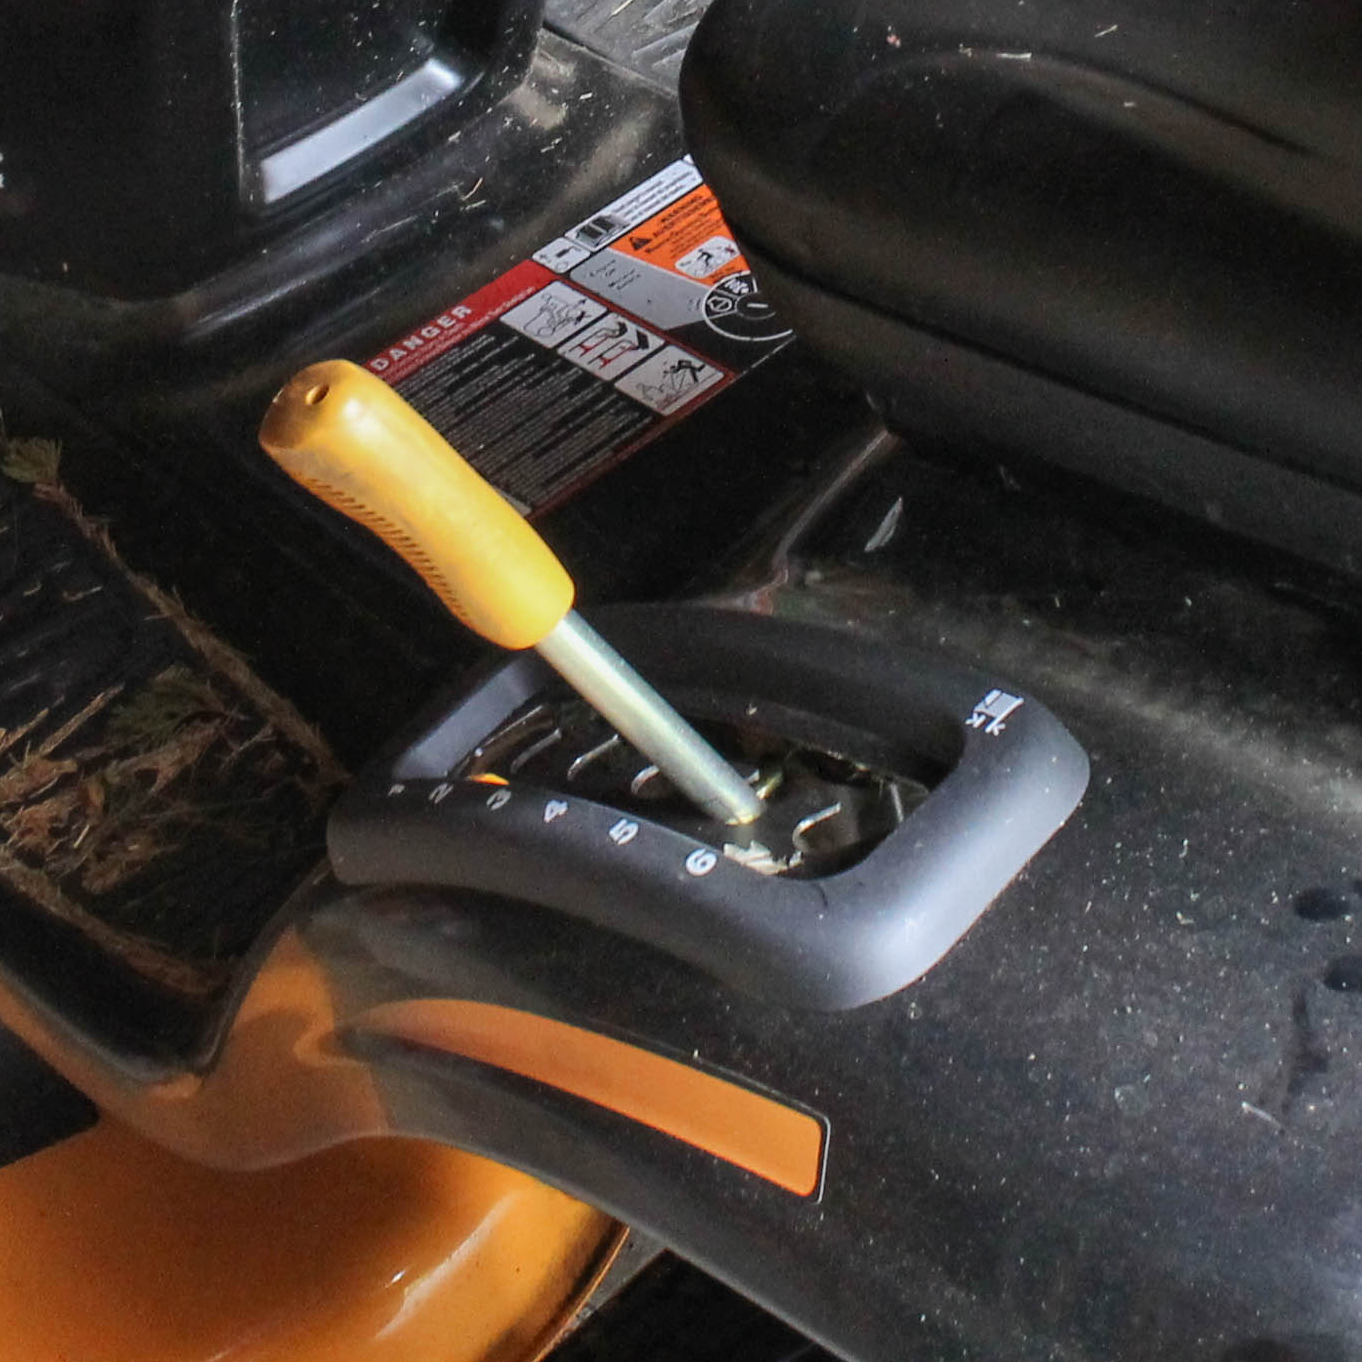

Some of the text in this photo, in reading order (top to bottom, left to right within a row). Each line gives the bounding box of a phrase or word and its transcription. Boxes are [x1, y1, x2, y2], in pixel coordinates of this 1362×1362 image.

[369, 305, 472, 371] DANGER
[544, 798, 569, 823] 4
[608, 818, 639, 846] 5
[685, 847, 718, 877] 6
